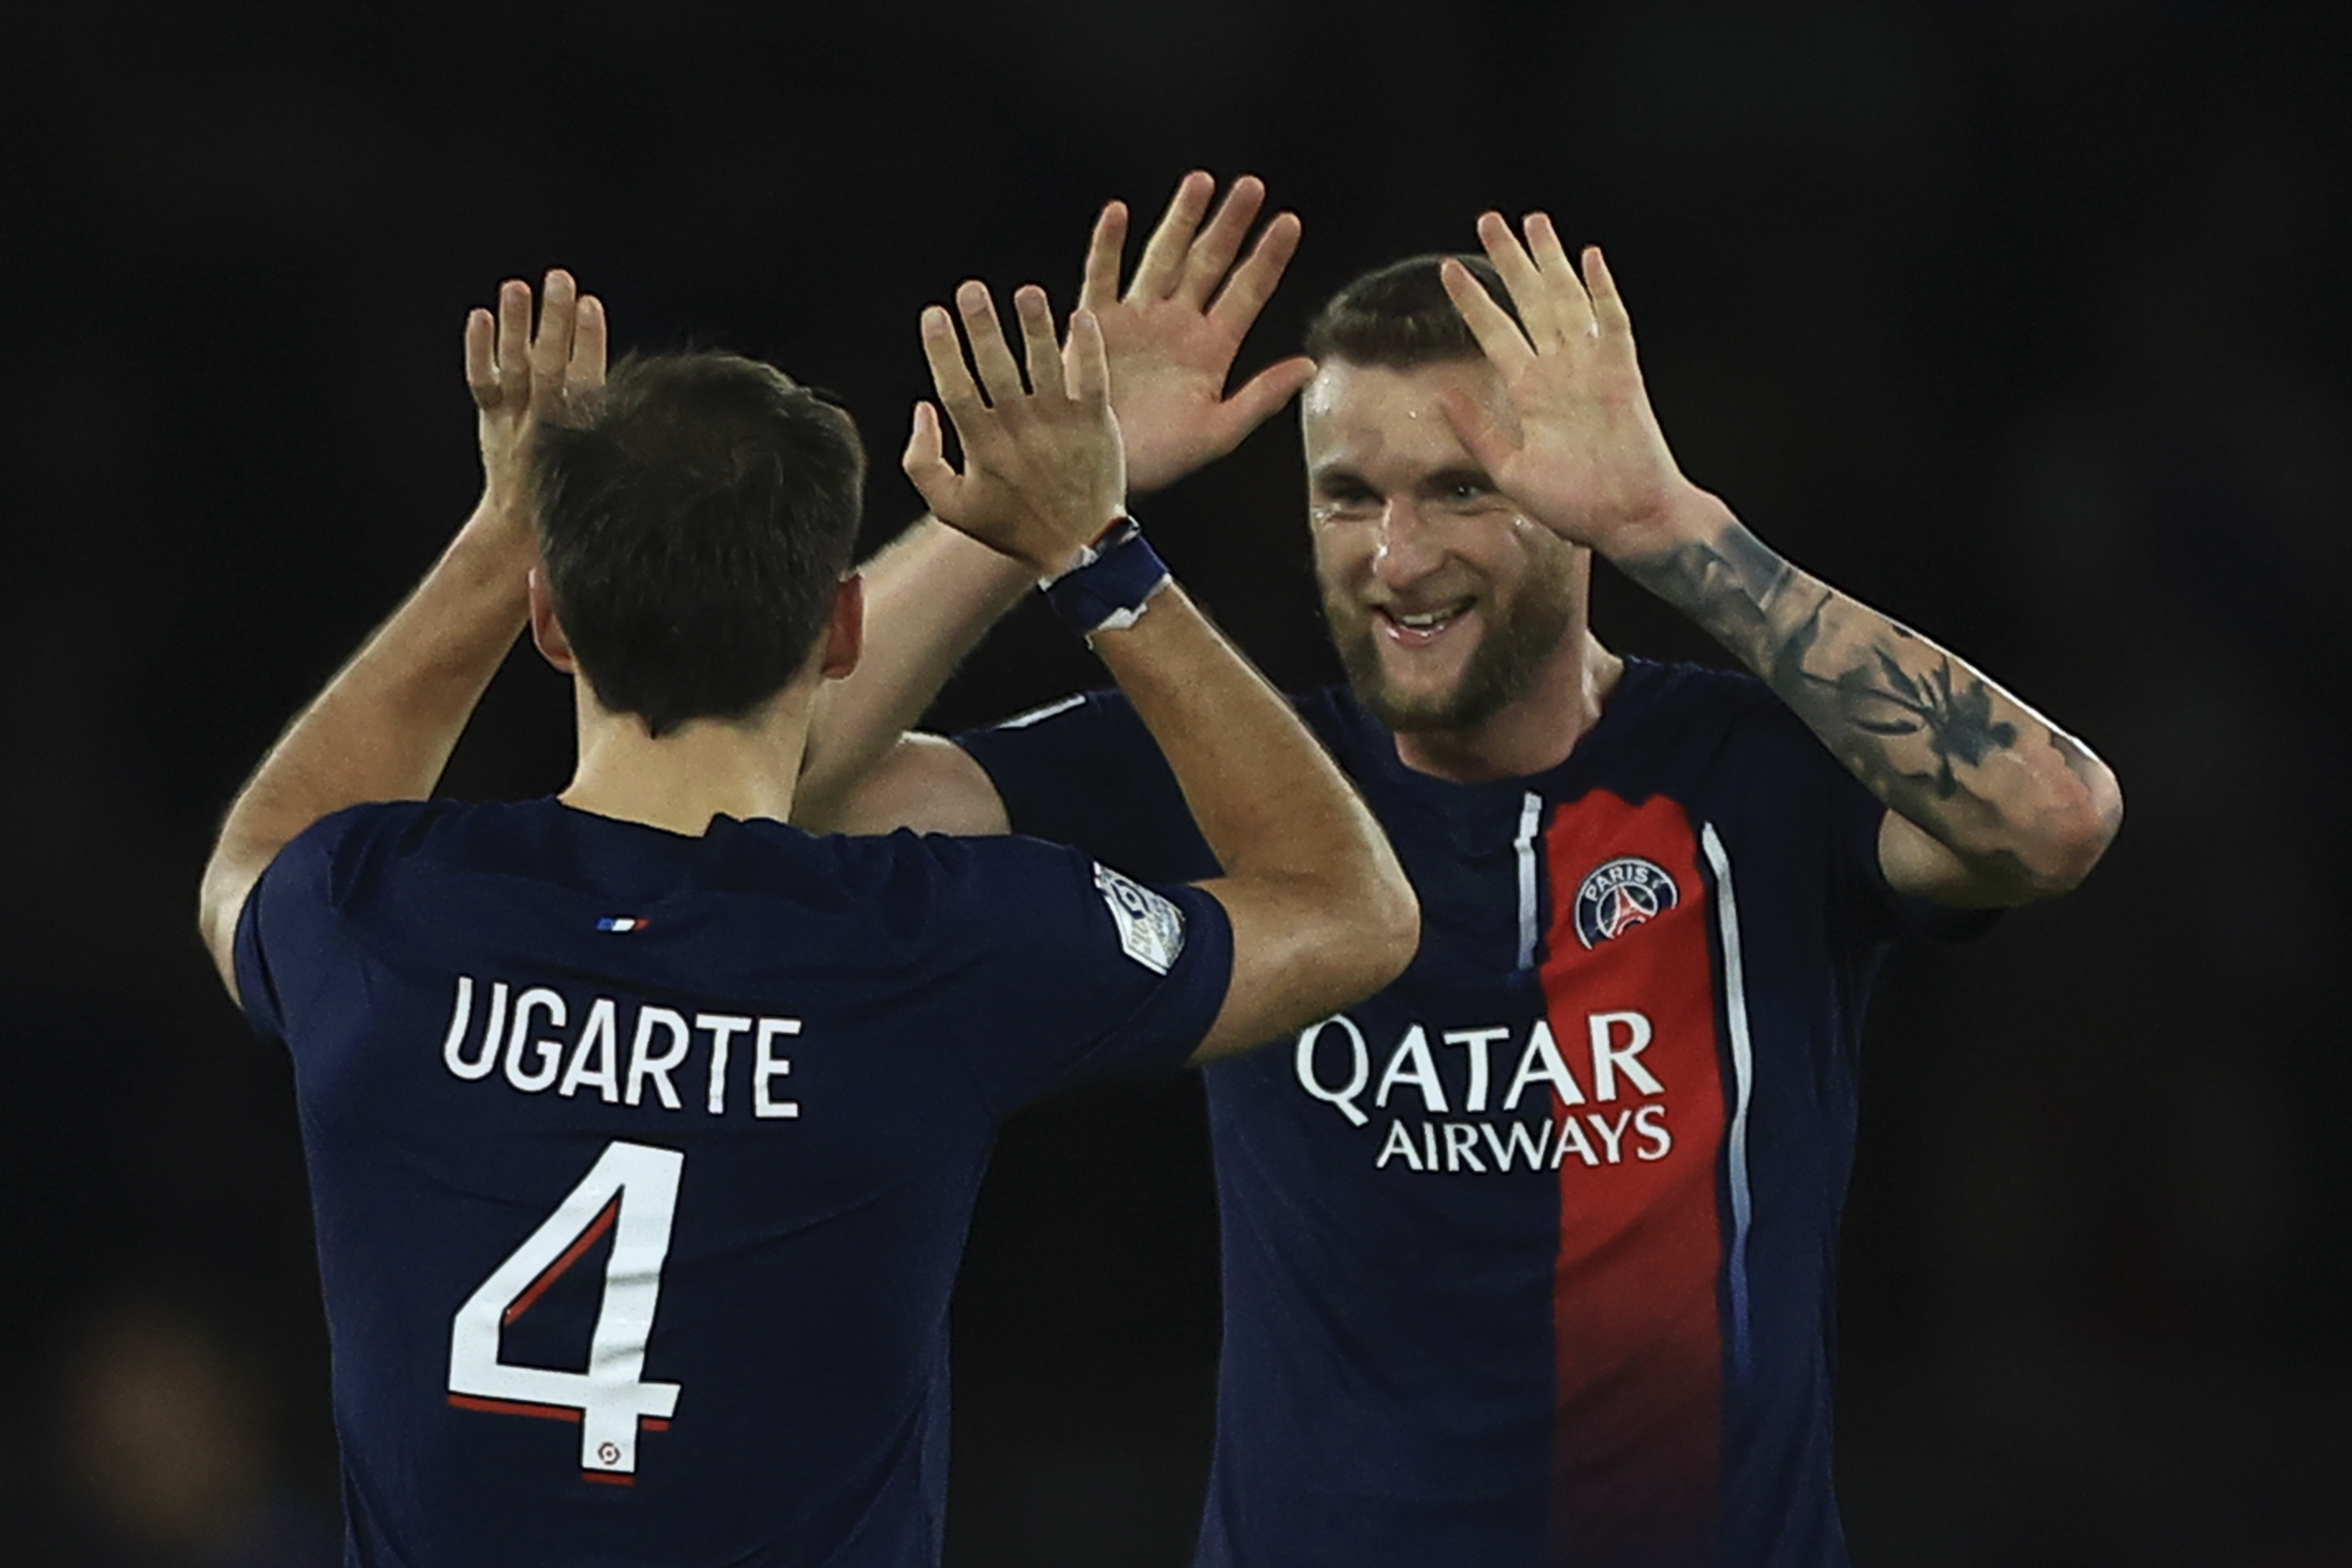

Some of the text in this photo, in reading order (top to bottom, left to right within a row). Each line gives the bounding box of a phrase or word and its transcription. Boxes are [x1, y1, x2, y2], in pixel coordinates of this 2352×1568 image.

[1585, 864, 1649, 901] PARIS
[443, 977, 802, 1117] UGARTE
[1297, 1011, 1664, 1127] QATAR
[1376, 1106, 1671, 1172] AIRWAYS
[449, 1141, 684, 1474] 4
